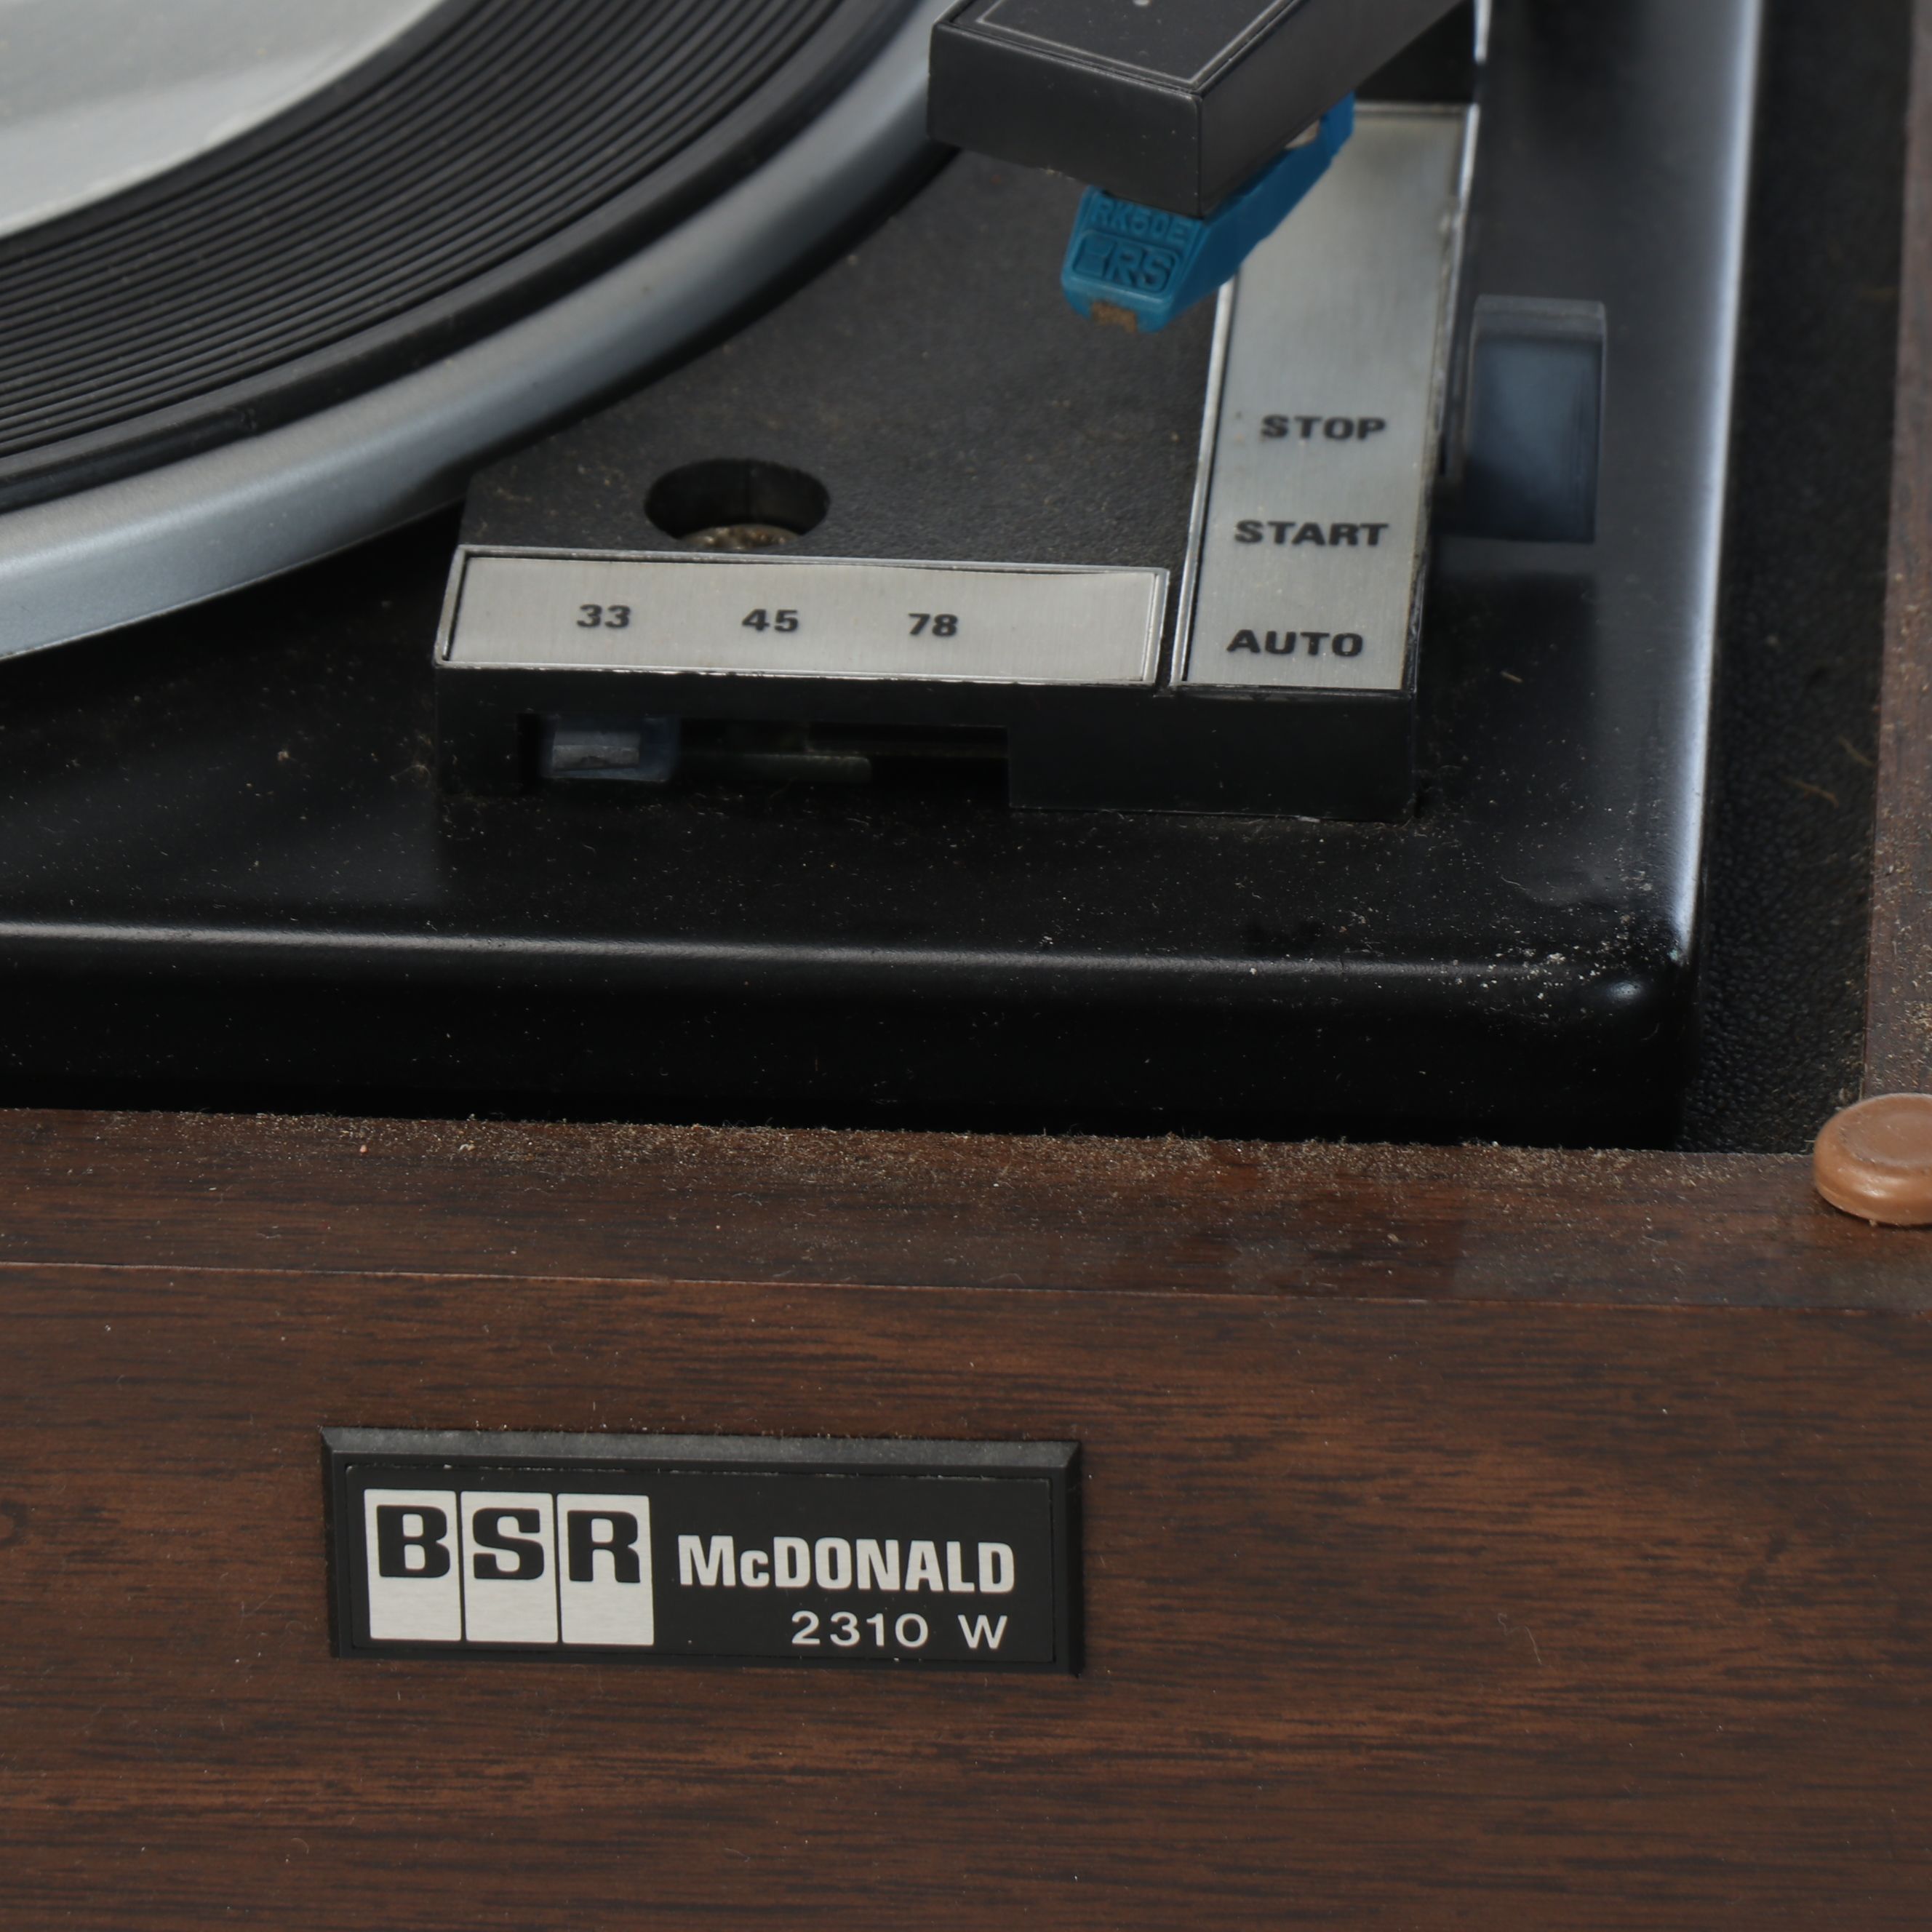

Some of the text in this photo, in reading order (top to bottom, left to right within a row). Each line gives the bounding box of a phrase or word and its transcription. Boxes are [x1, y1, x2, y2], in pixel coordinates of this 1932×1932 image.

[1261, 414, 1386, 441] STOP
[1234, 519, 1389, 547] START
[577, 604, 631, 628] 33
[742, 608, 799, 632] 45
[909, 613, 958, 637] 78
[1226, 628, 1365, 658] AUTO
[376, 1504, 641, 1584] BSR
[678, 1534, 1015, 1594] McDONALD
[791, 1610, 1008, 1650] 2310 W
